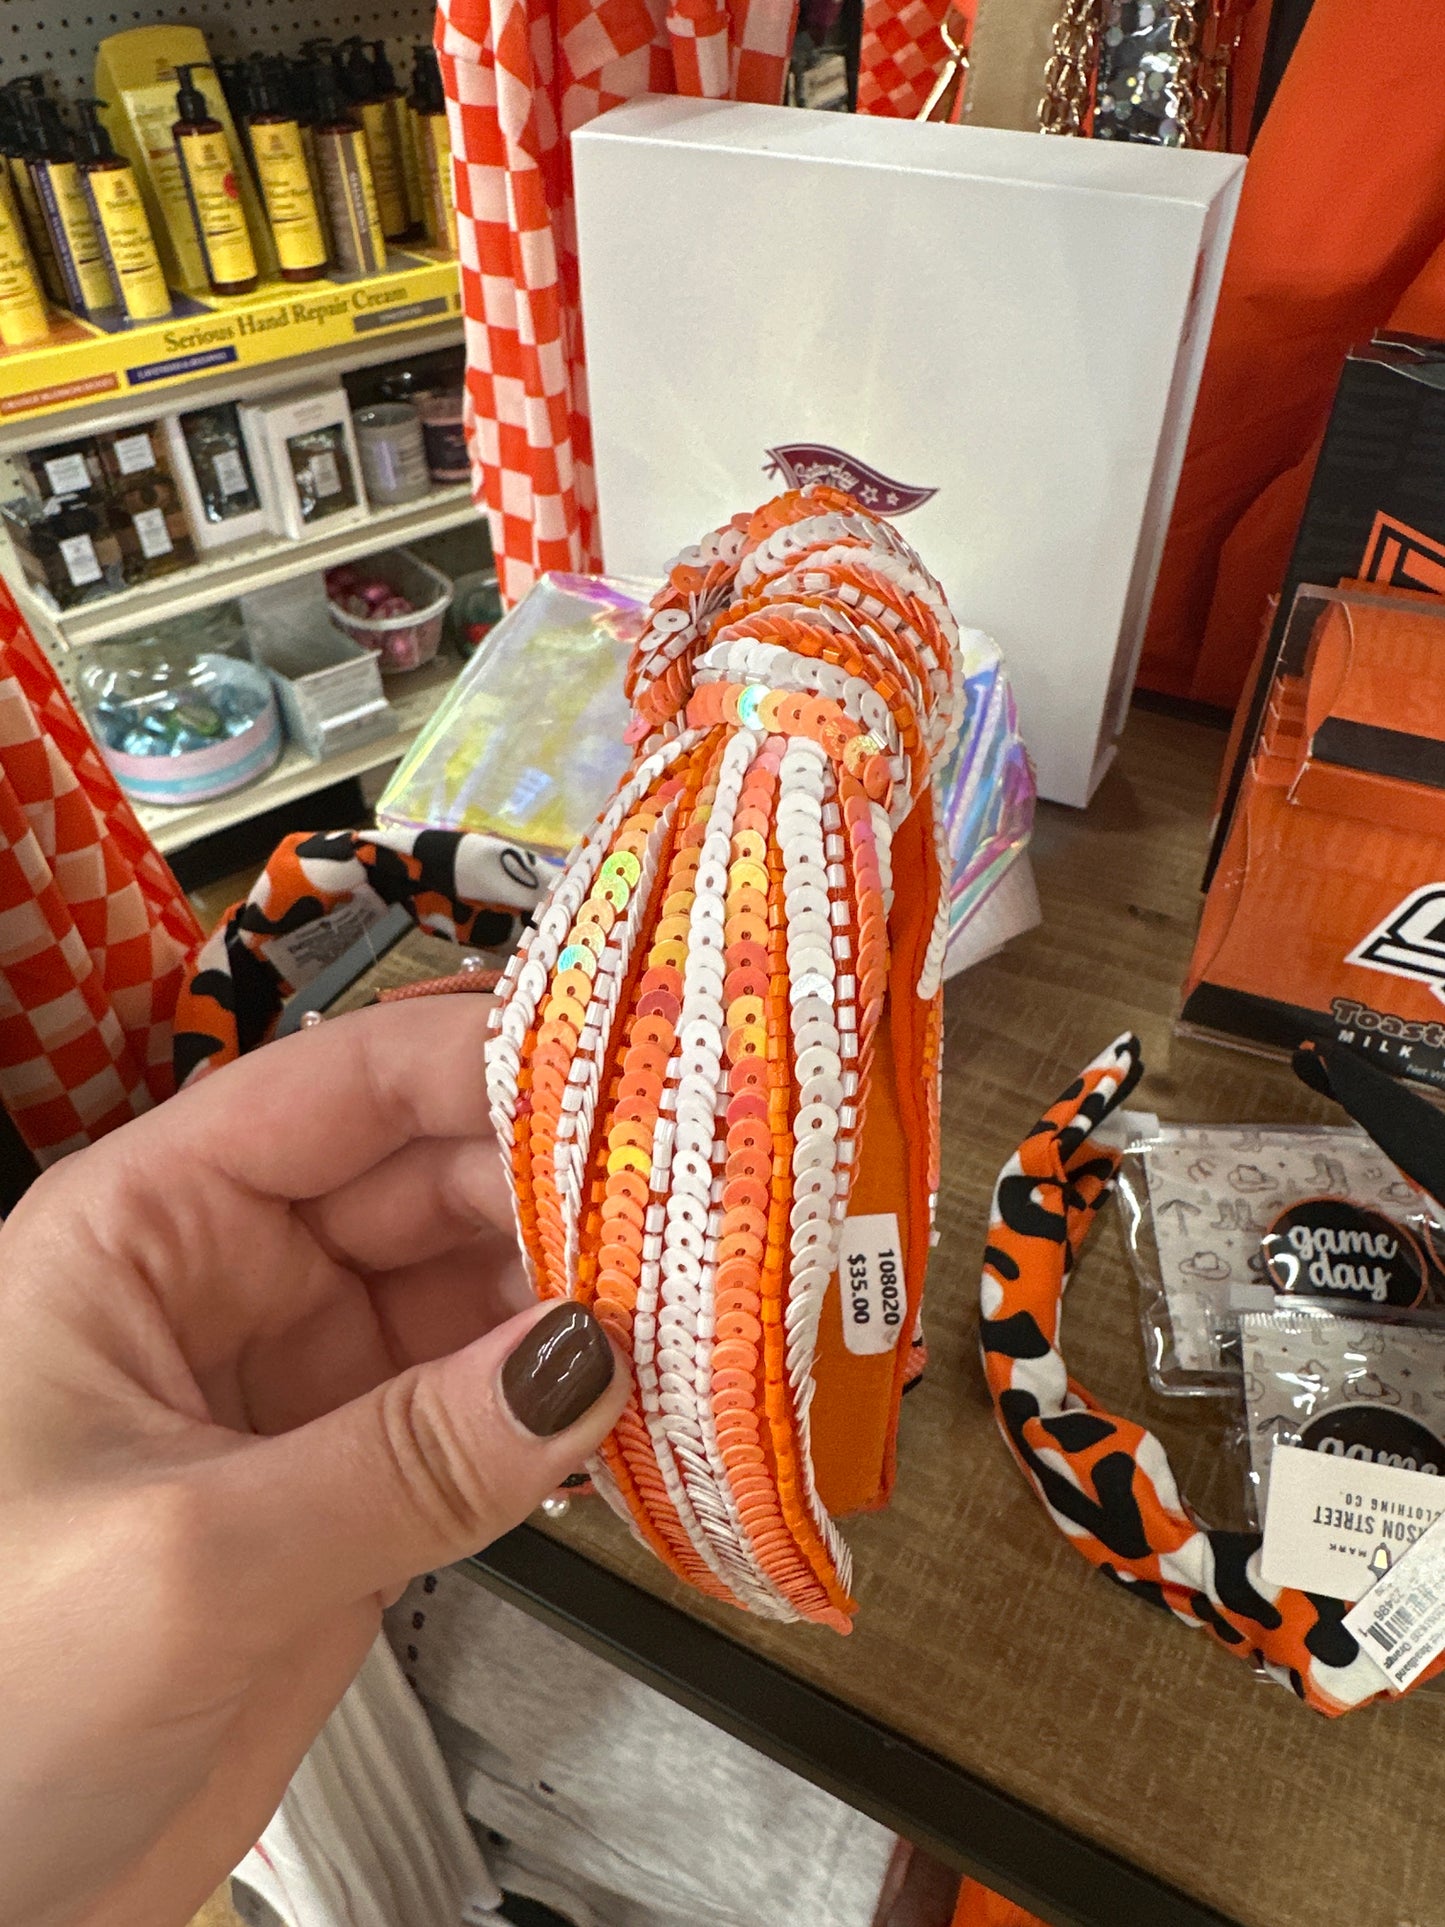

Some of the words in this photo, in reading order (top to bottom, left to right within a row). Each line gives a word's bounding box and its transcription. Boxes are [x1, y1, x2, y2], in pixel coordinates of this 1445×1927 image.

[163, 326, 234, 352] Serious
[236, 311, 290, 338] Hand
[292, 298, 348, 326] Repair
[351, 287, 408, 311] Cream
[1330, 997, 1445, 1048] Toast
[1337, 1029, 1413, 1059] MILK
[1287, 1225, 1399, 1261] game
[847, 1253, 870, 1325] $35.00
[878, 1248, 901, 1326] 108020
[1308, 1251, 1393, 1302] day
[1312, 1505, 1375, 1535] STREET
[1382, 1519, 1427, 1543] SON
[1329, 1542, 1368, 1558] MARK
[1384, 1641, 1412, 1670] Orange
